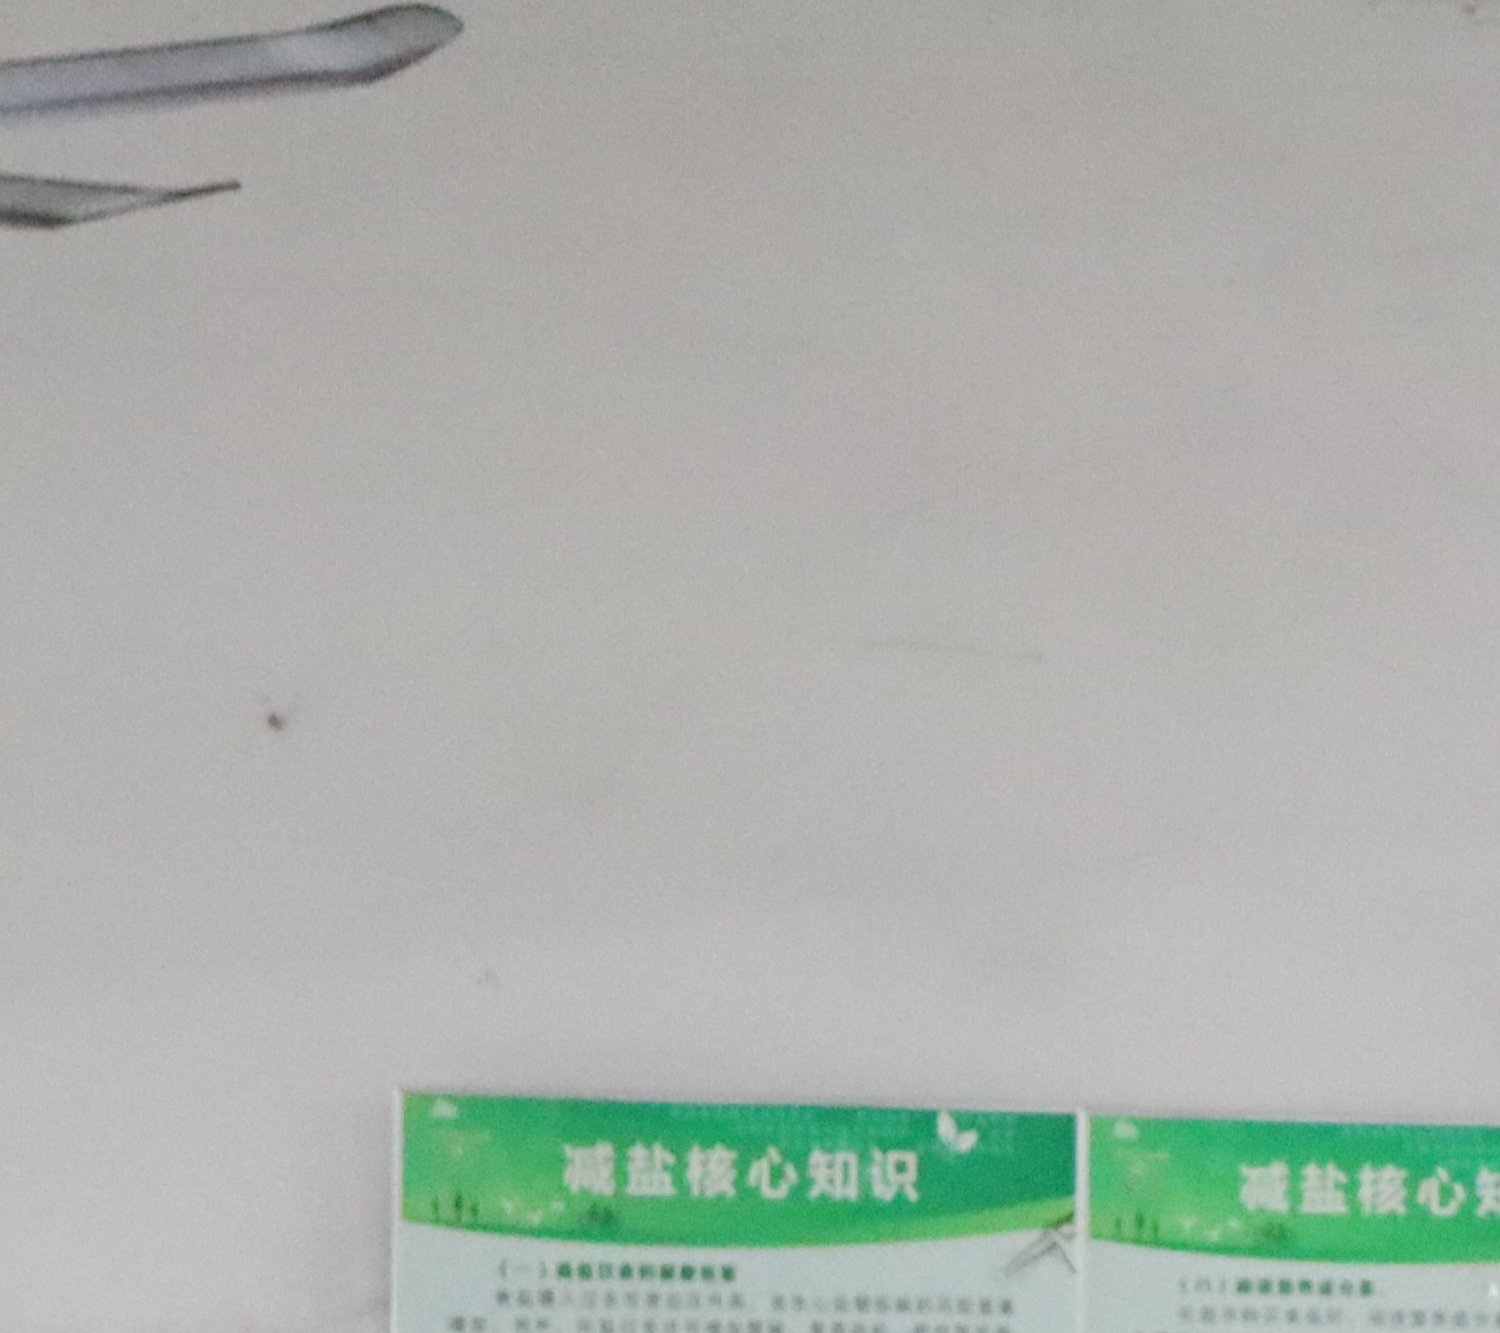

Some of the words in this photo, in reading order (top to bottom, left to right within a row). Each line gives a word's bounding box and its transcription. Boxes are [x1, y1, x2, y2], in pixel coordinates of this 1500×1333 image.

[564, 1142, 921, 1203] 减盐核心知识
